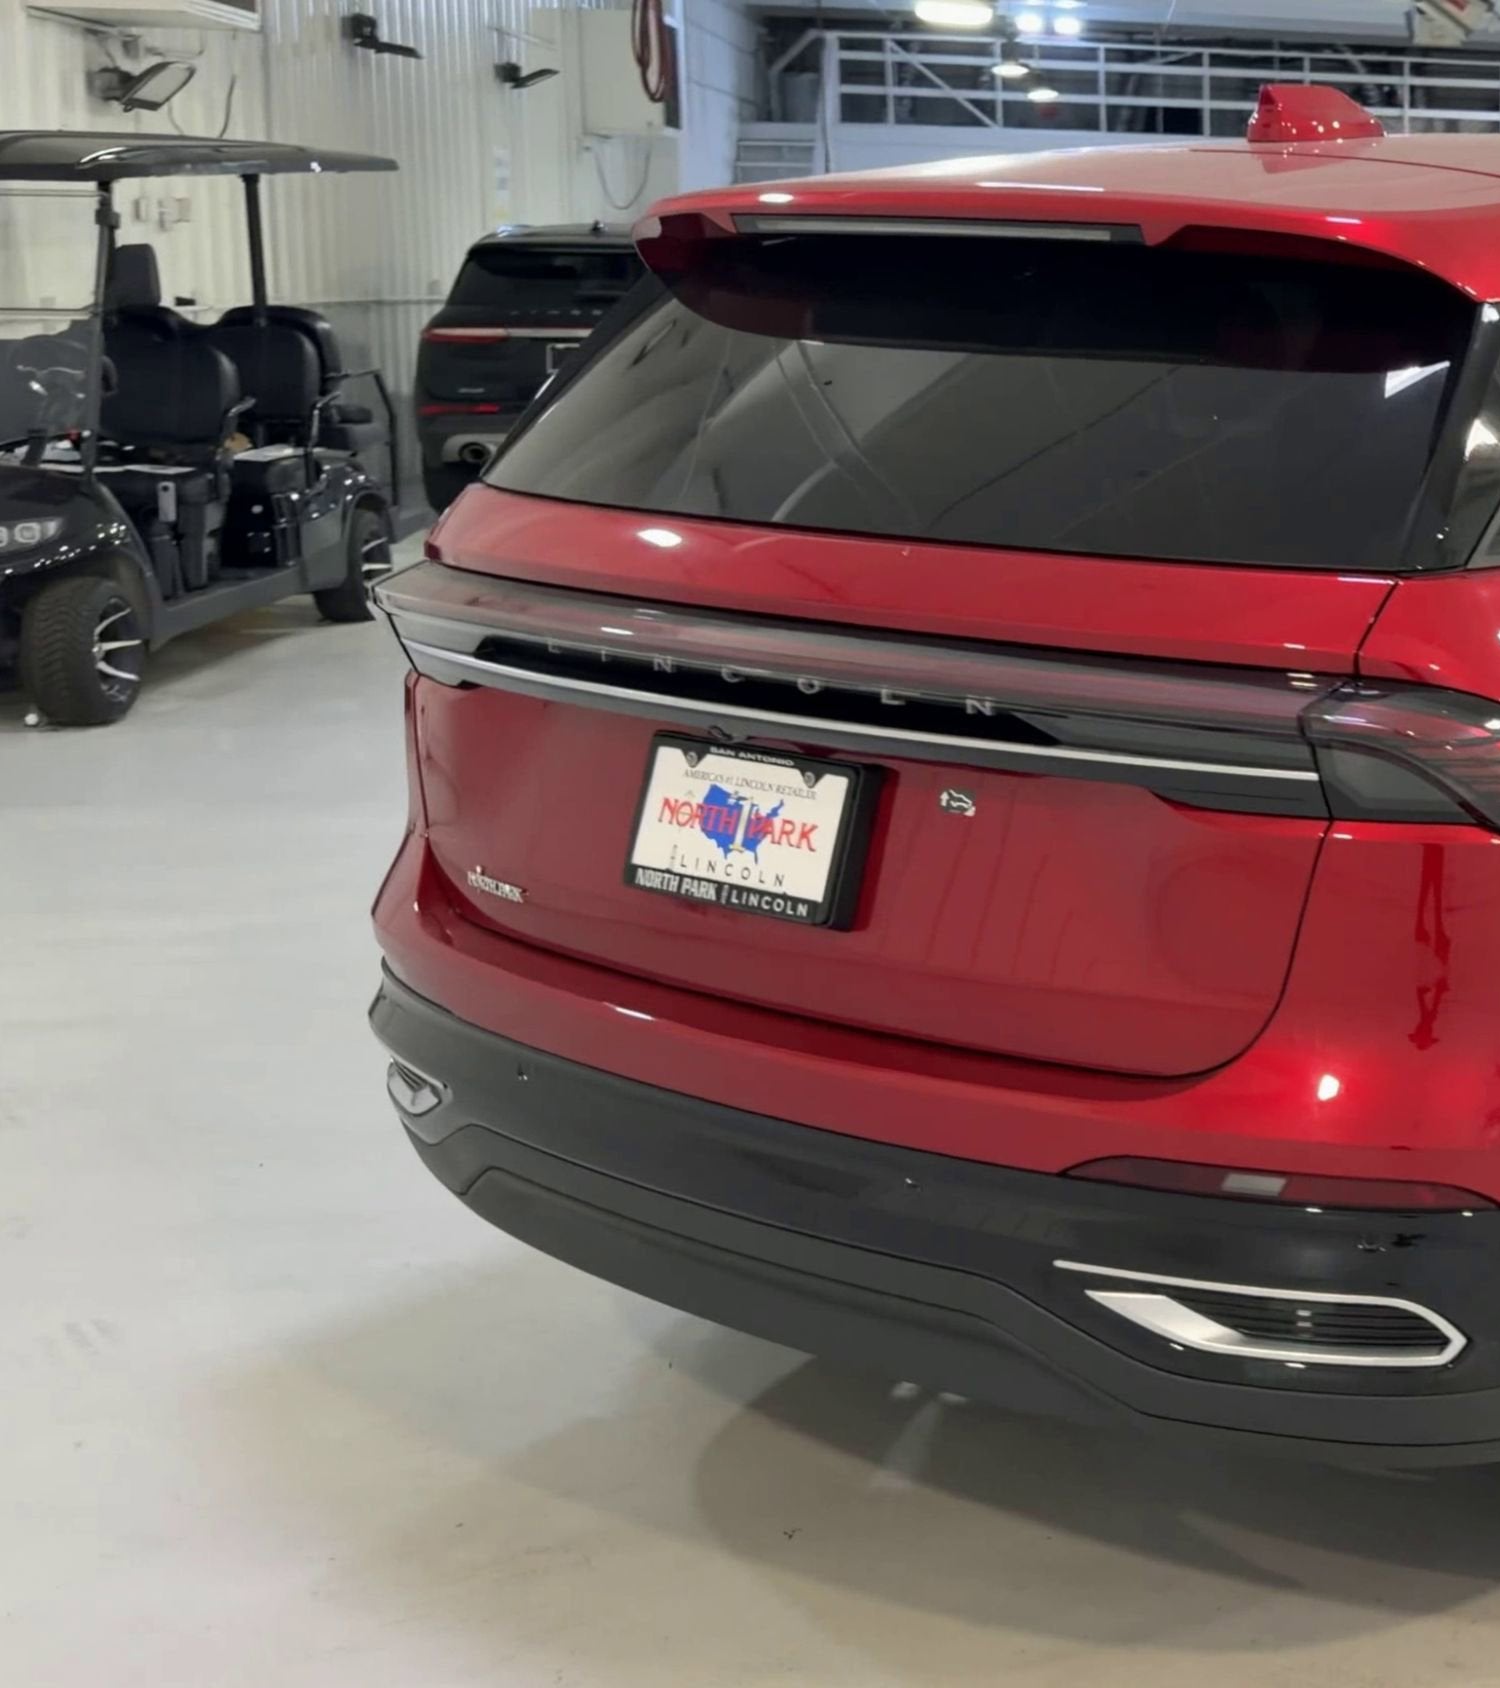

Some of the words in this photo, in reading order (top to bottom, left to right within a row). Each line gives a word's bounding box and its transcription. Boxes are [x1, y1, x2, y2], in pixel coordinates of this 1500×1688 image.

[547, 637, 999, 717] LINCOLN
[657, 797, 738, 836] NORTH
[748, 808, 819, 853] PARK
[635, 868, 680, 893] NORTH
[680, 878, 718, 901] PARK
[731, 889, 809, 918] LINCOLN
[680, 854, 785, 888] LINCOLN
